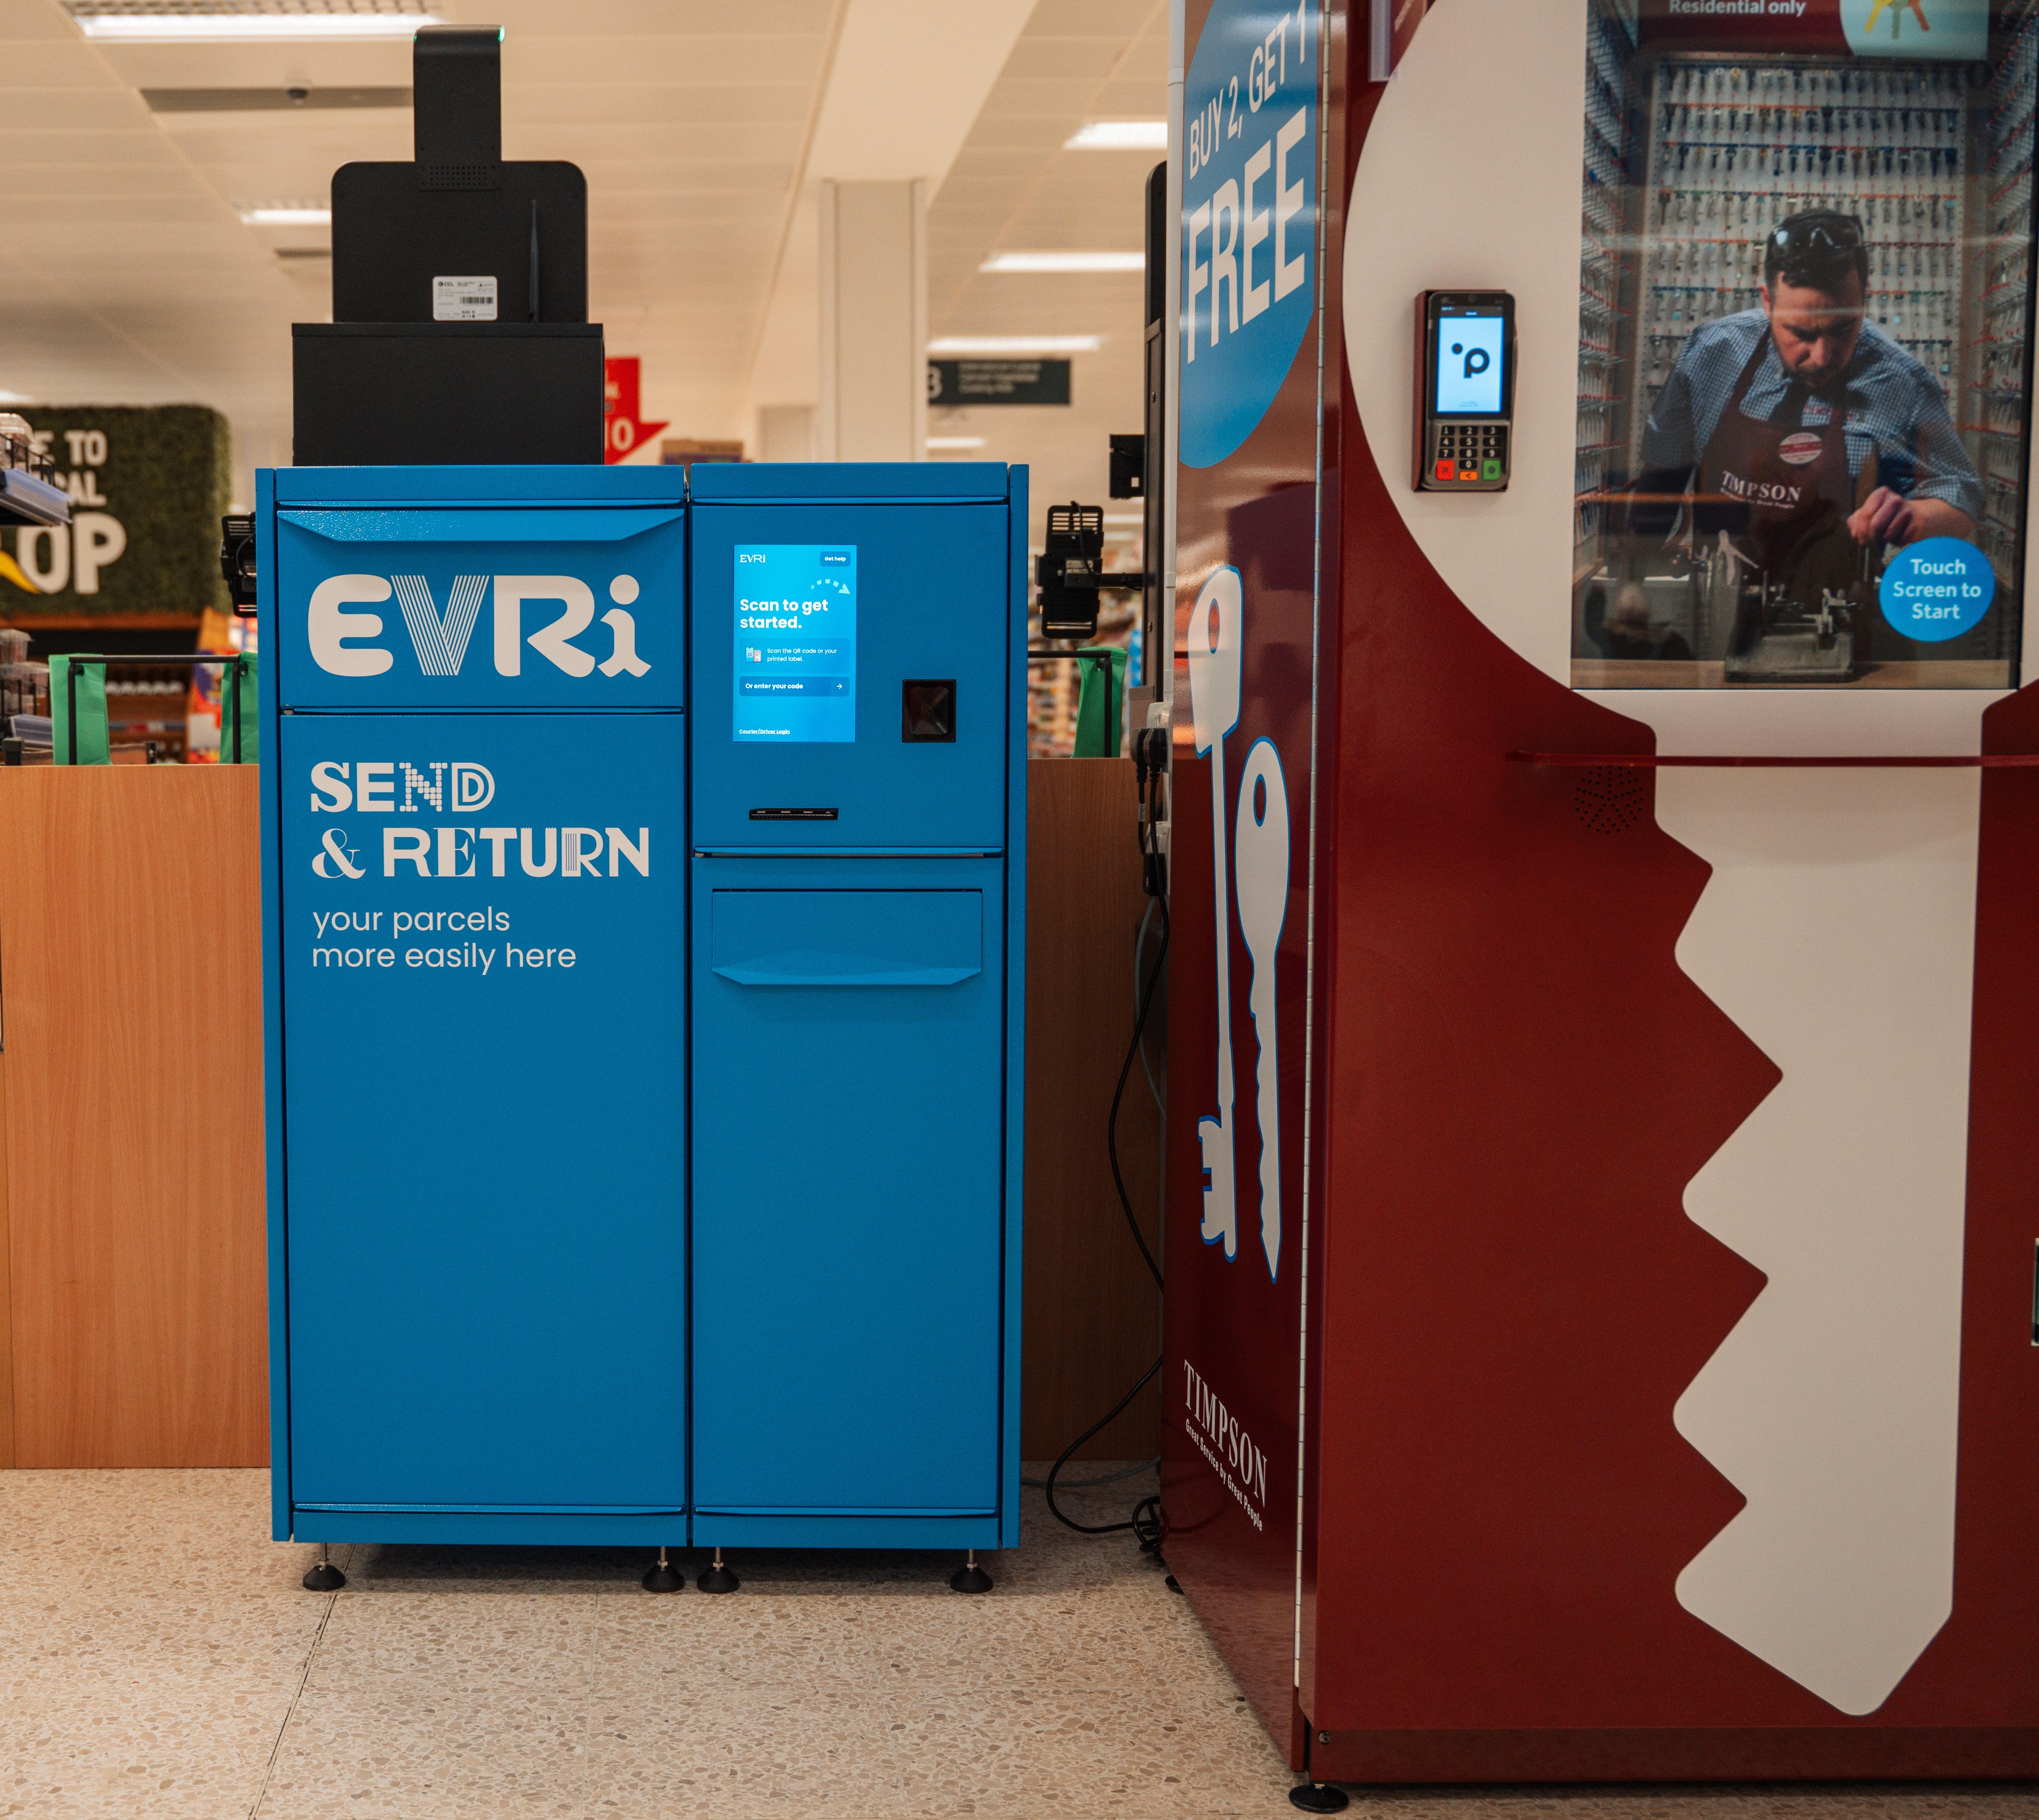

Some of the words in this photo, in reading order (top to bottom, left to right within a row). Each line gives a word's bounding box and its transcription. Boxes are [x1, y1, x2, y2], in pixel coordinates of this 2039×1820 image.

[1669, 0, 1765, 13] Residential
[1768, 0, 1806, 17] only
[1190, 88, 1223, 180] BUY
[1228, 75, 1243, 140] 2,
[1249, 12, 1290, 113] GET
[1297, 0, 1306, 64] 1
[1187, 105, 1306, 364] FREE
[1467, 426, 1473, 435] 2
[64, 430, 108, 466] TO
[1466, 449, 1472, 457] 8
[1489, 449, 1495, 457] 9
[1466, 460, 1472, 468] 0
[1723, 471, 1802, 501] TIMPSON
[0, 512, 127, 594] OP
[740, 554, 766, 563] EVRi
[1910, 559, 1966, 574] Touch
[1893, 581, 1956, 597] Screen
[1961, 583, 1981, 597] to
[740, 599, 779, 611] Scan
[782, 599, 799, 611] to
[802, 599, 828, 615] get
[740, 616, 802, 628] started.
[1912, 603, 1960, 619] Start
[308, 574, 652, 677] EVRi
[311, 761, 496, 812] SEND
[311, 828, 366, 879] &
[383, 827, 649, 877] RETURN
[313, 911, 383, 939] your
[394, 906, 510, 939] parcels
[313, 947, 395, 968] more
[405, 942, 496, 975] easily
[506, 943, 577, 968] here
[1184, 1359, 1268, 1508] TIMPSON
[1186, 1418, 1199, 1446] Great
[1200, 1437, 1218, 1471] Service
[1220, 1463, 1226, 1484] by
[1227, 1474, 1242, 1504] Great
[1244, 1495, 1263, 1531] People
